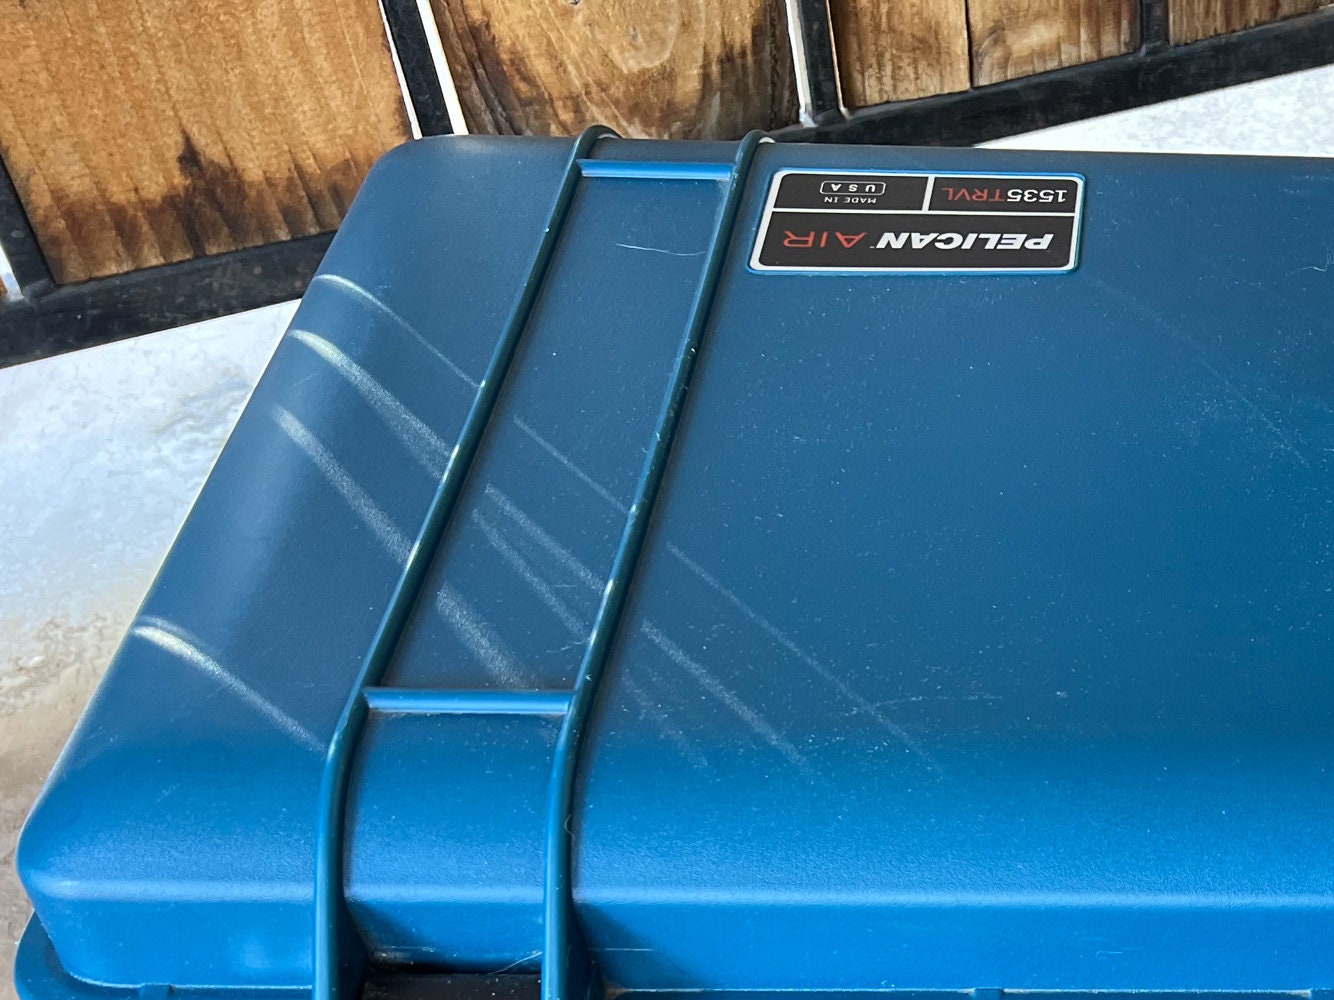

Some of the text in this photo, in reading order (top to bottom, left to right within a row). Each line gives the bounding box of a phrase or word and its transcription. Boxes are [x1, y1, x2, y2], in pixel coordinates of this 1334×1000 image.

[843, 196, 877, 204] MADE
[783, 230, 1054, 250] PELICAN AIR
